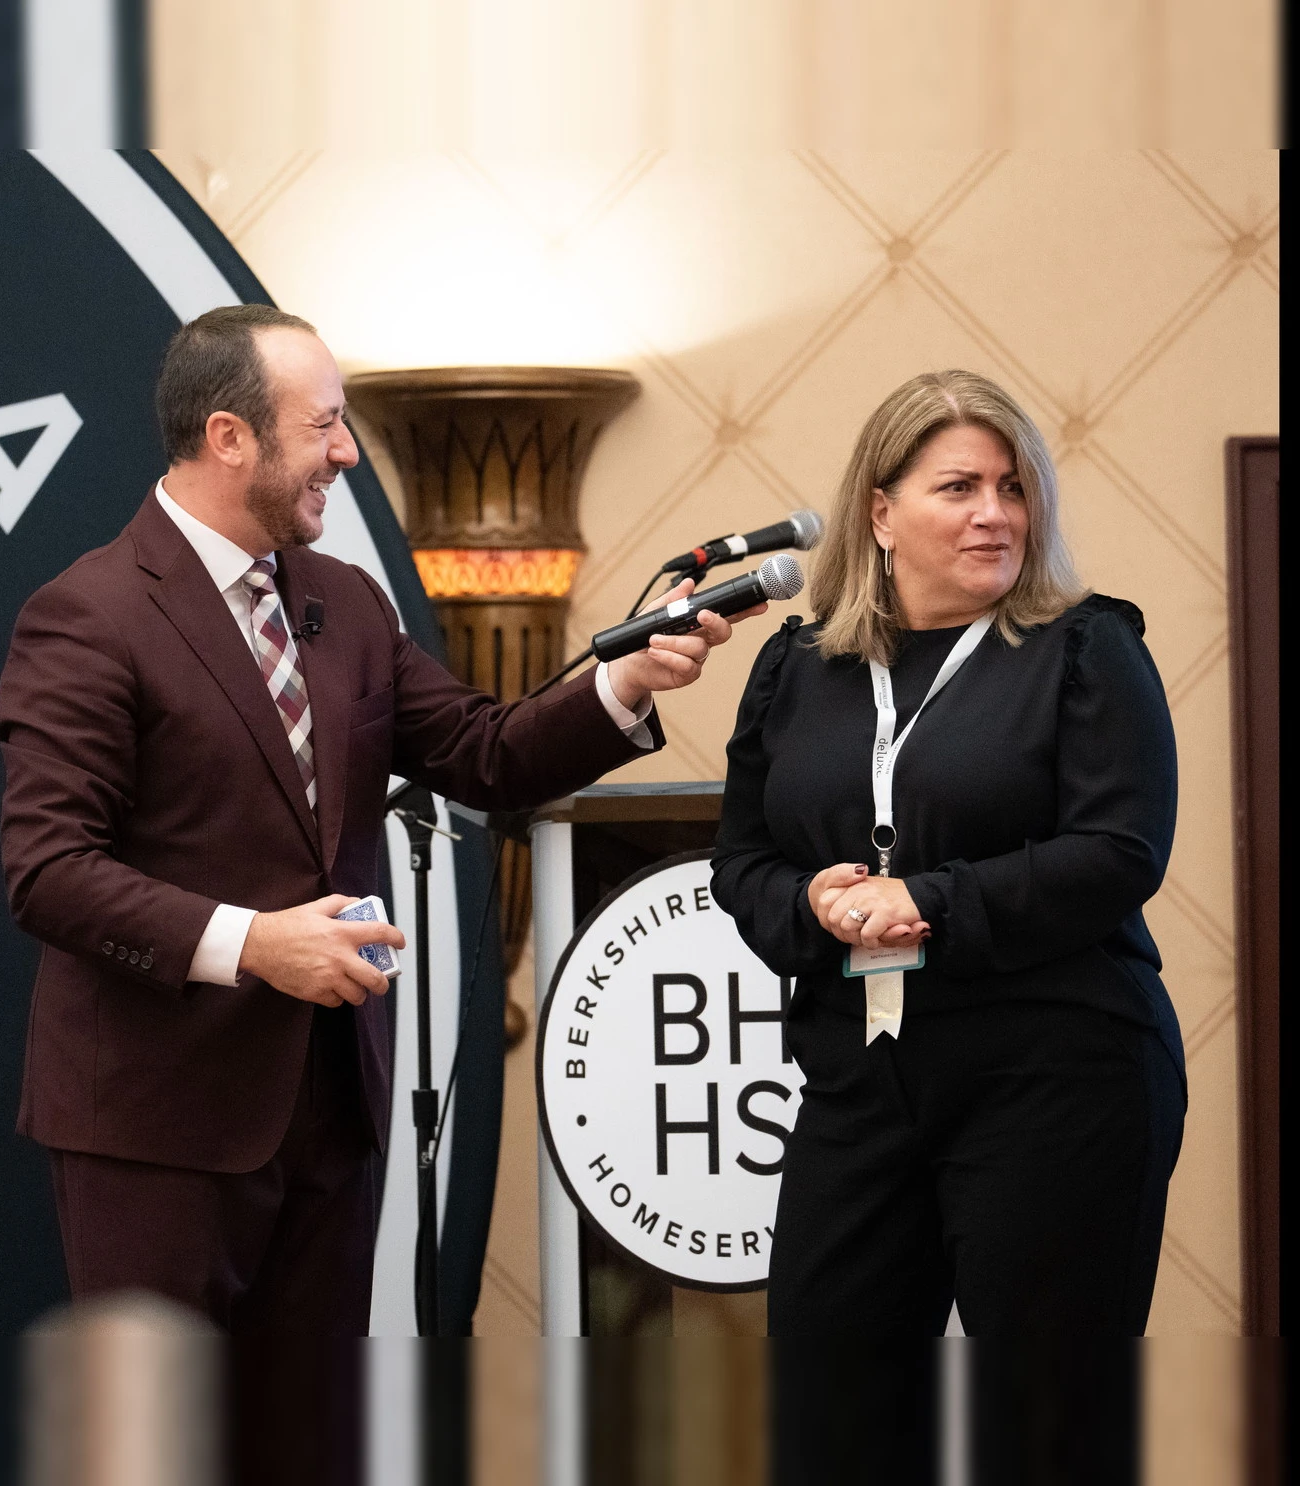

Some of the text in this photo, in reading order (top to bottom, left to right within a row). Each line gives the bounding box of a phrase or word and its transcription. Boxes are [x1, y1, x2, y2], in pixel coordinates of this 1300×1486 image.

[566, 886, 710, 1079] BERKSHIRE
[653, 972, 794, 1066] BH
[655, 1080, 792, 1176] HS
